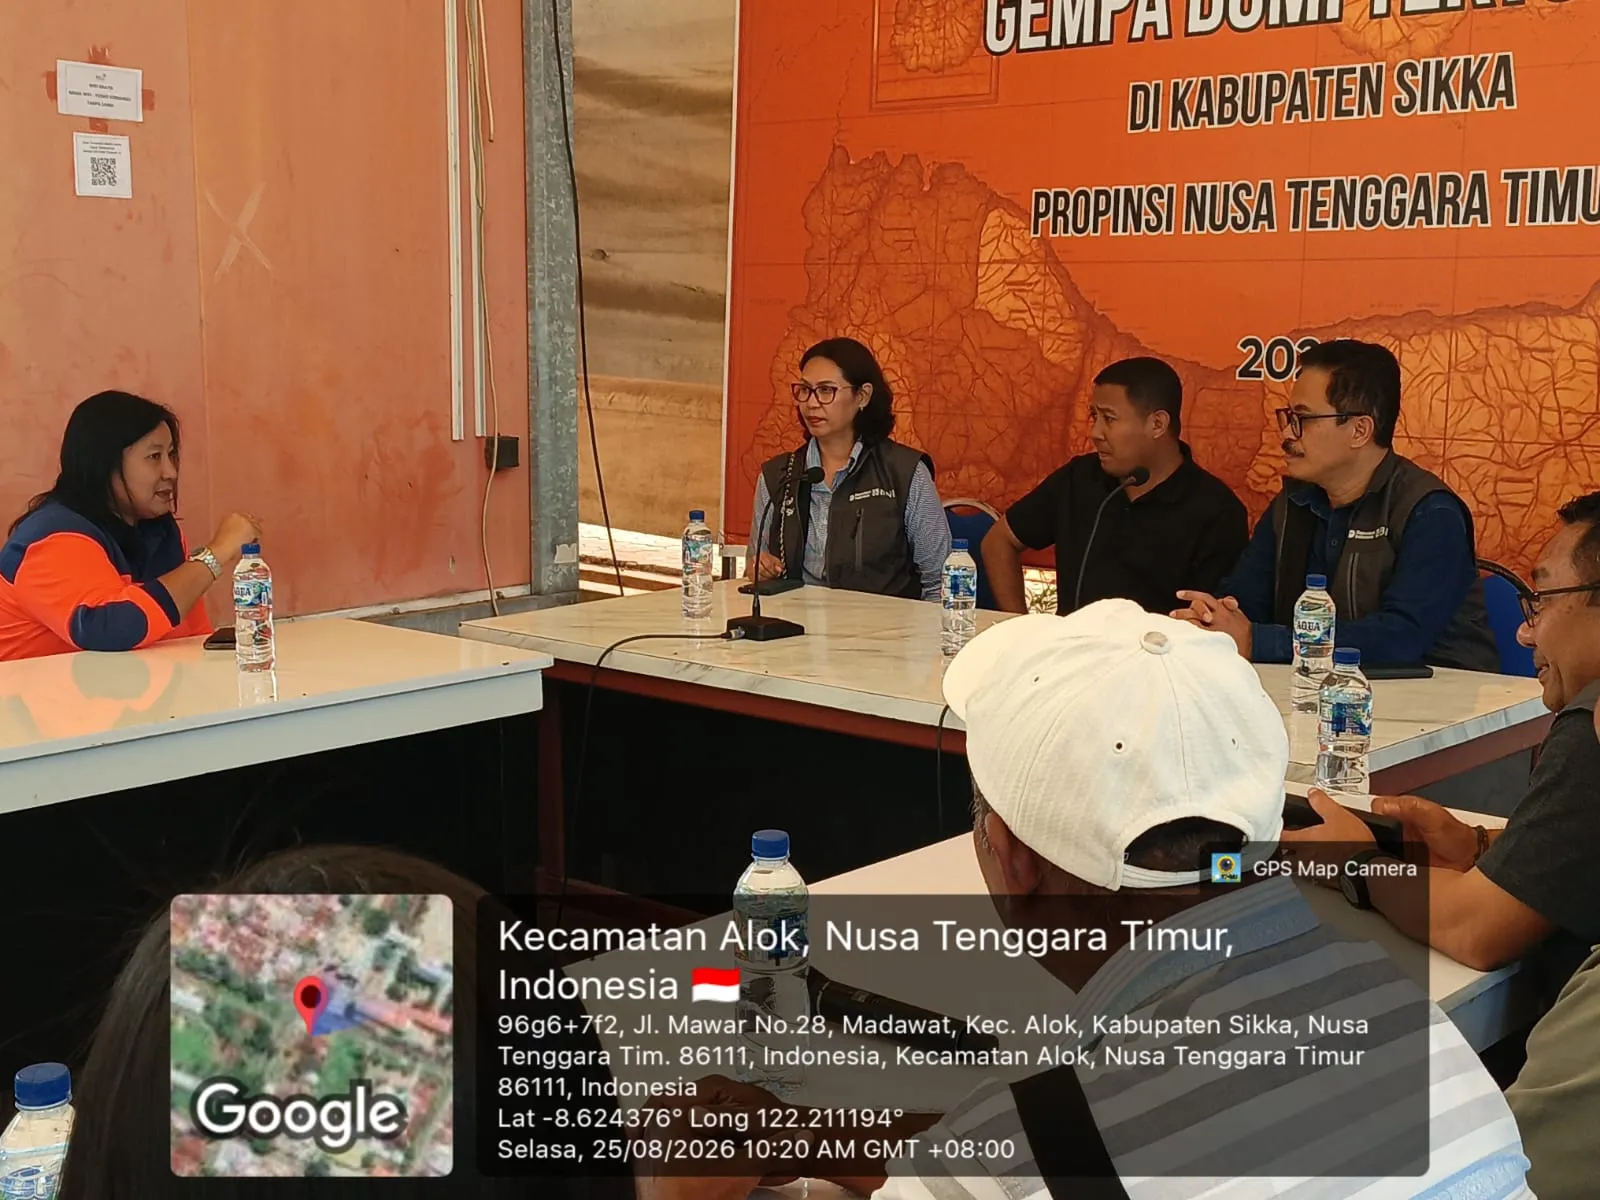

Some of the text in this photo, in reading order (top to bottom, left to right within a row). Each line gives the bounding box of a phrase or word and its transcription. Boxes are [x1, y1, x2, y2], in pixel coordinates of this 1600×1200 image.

[1128, 52, 1517, 133] DI KABUPATEN SIKKA
[1031, 166, 1600, 237] PROPINSI NUSA TENGGARA TIMU
[1296, 620, 1321, 633] AQUA
